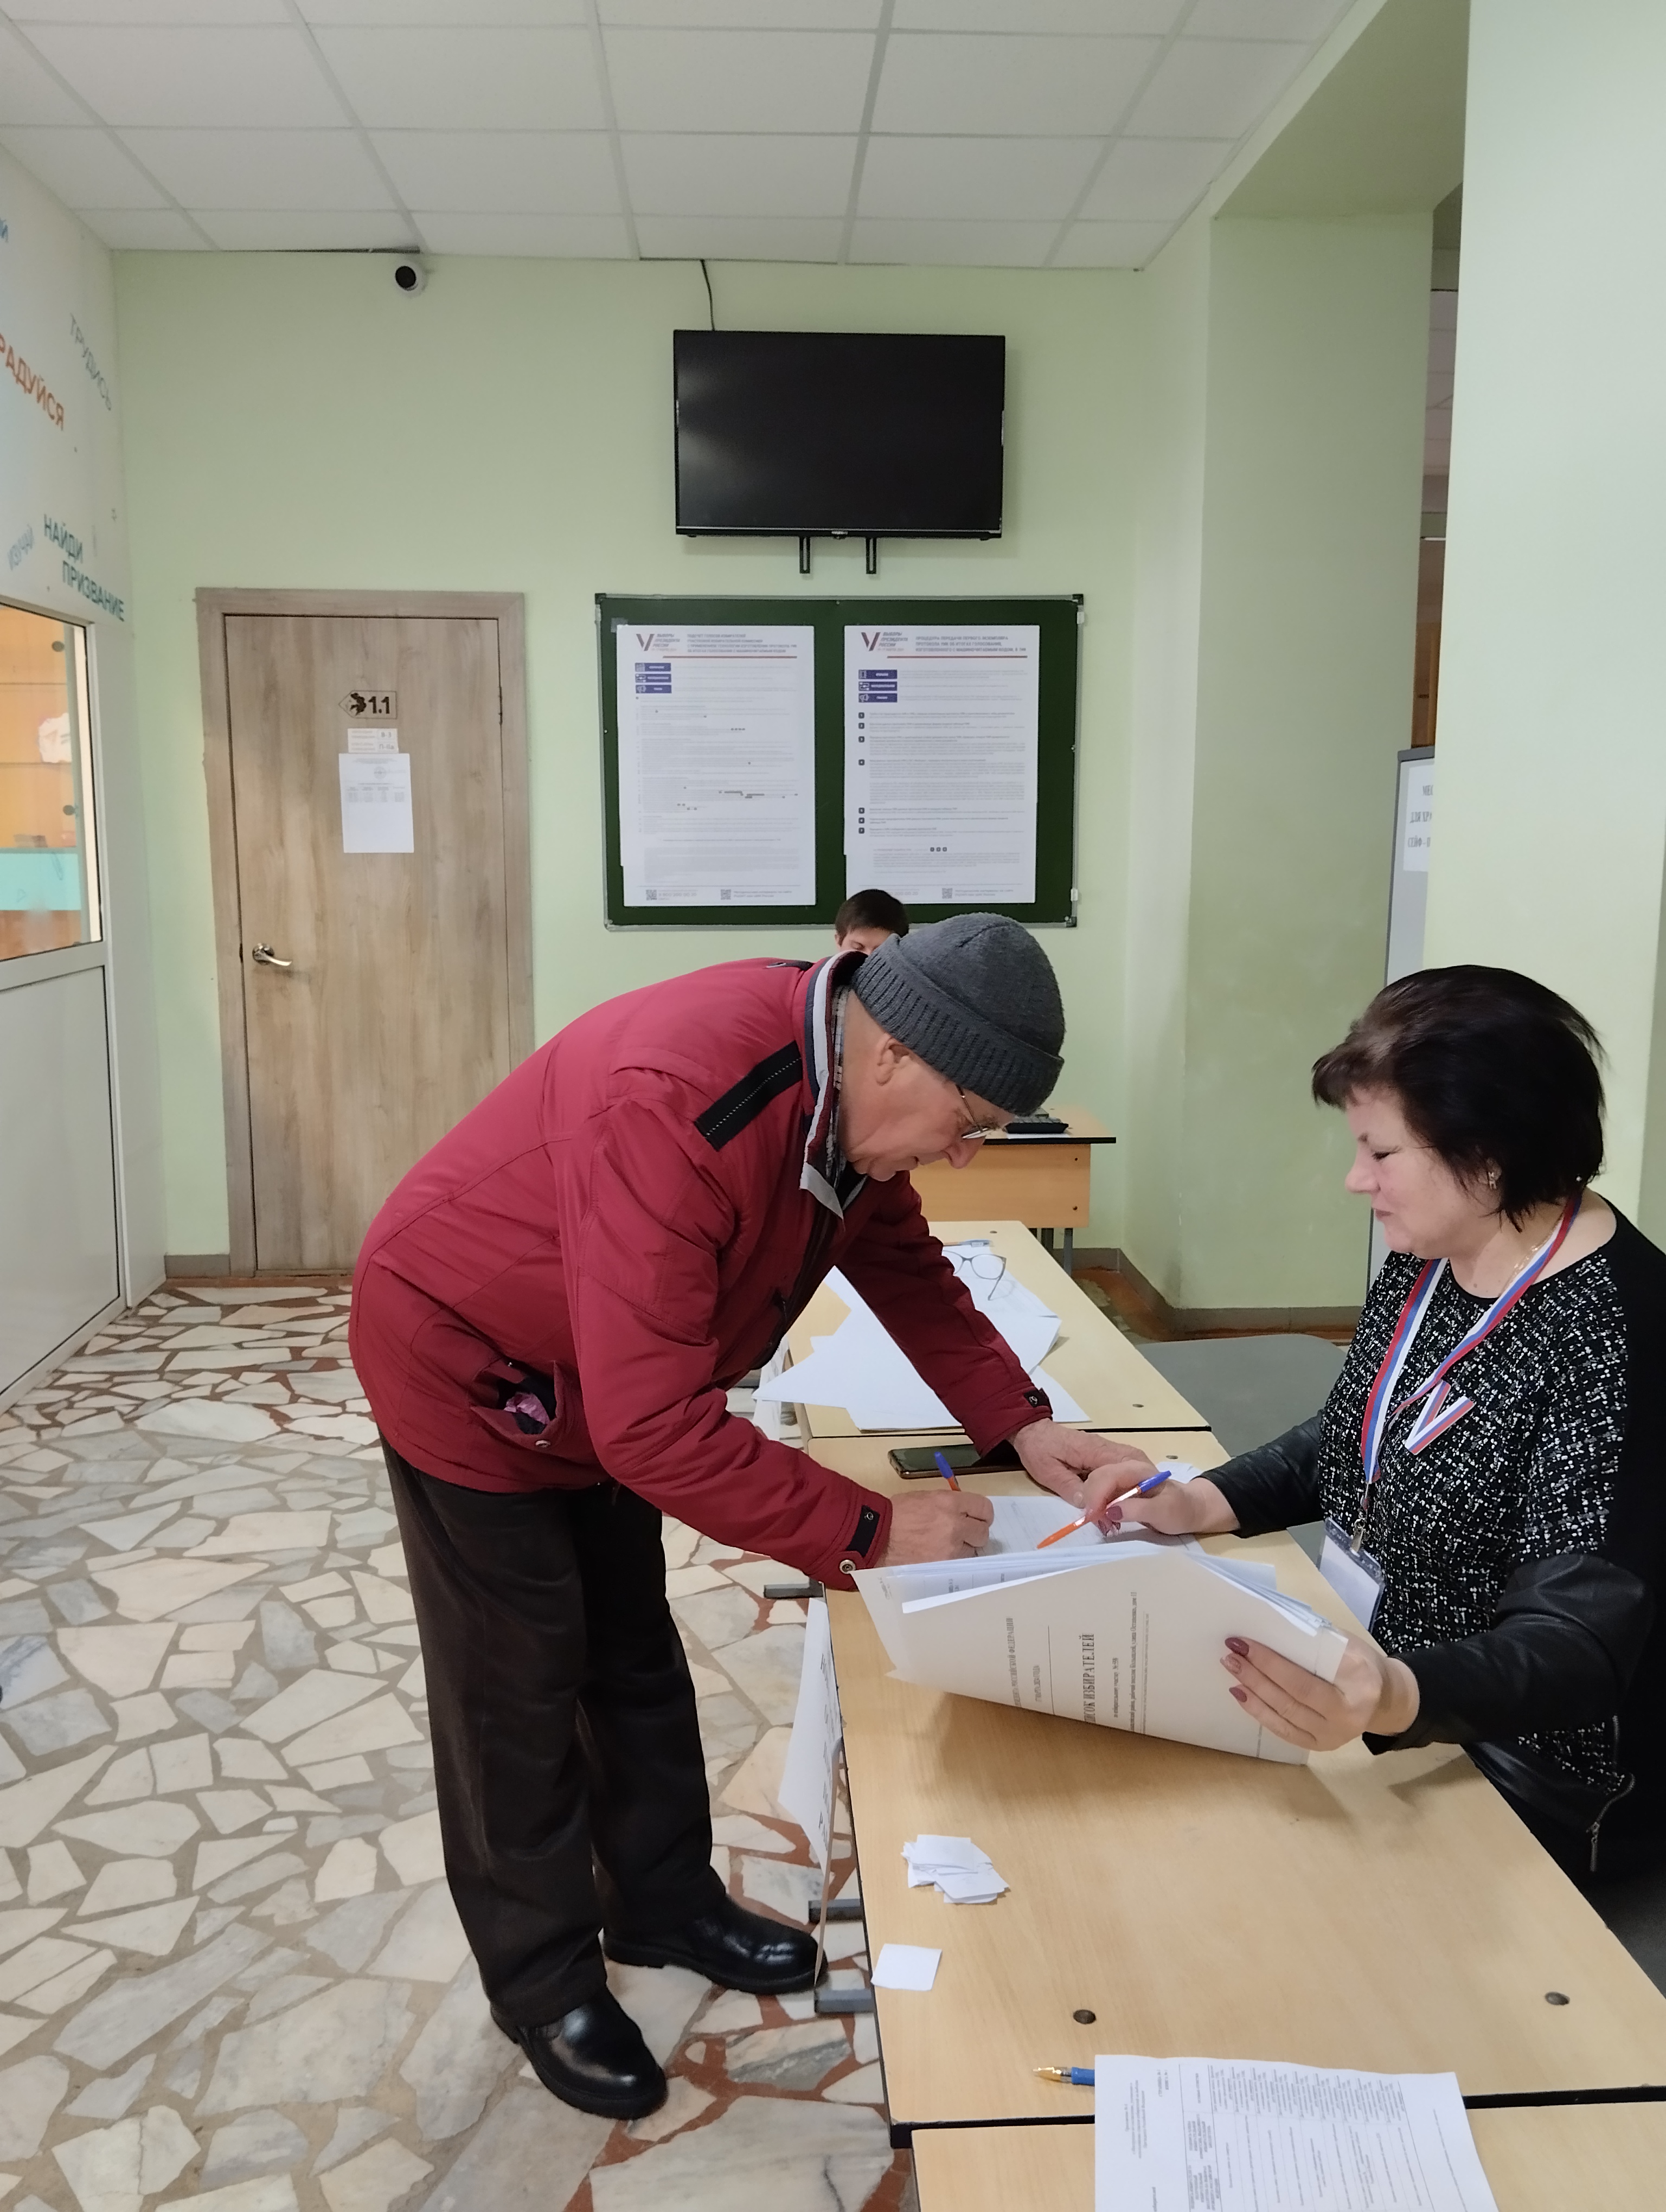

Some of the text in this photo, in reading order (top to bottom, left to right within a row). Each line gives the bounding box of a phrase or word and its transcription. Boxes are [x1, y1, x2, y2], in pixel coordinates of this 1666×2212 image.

[43, 513, 84, 564] НАЙДИ
[62, 560, 124, 622] ПРИЗВАНИЕ
[368, 696, 390, 714] 1.1
[1006, 1618, 1015, 1654] ФЕДЕРАЦИИ
[1079, 1633, 1095, 1700] ИЗБИРАТЕЛЕЙ
